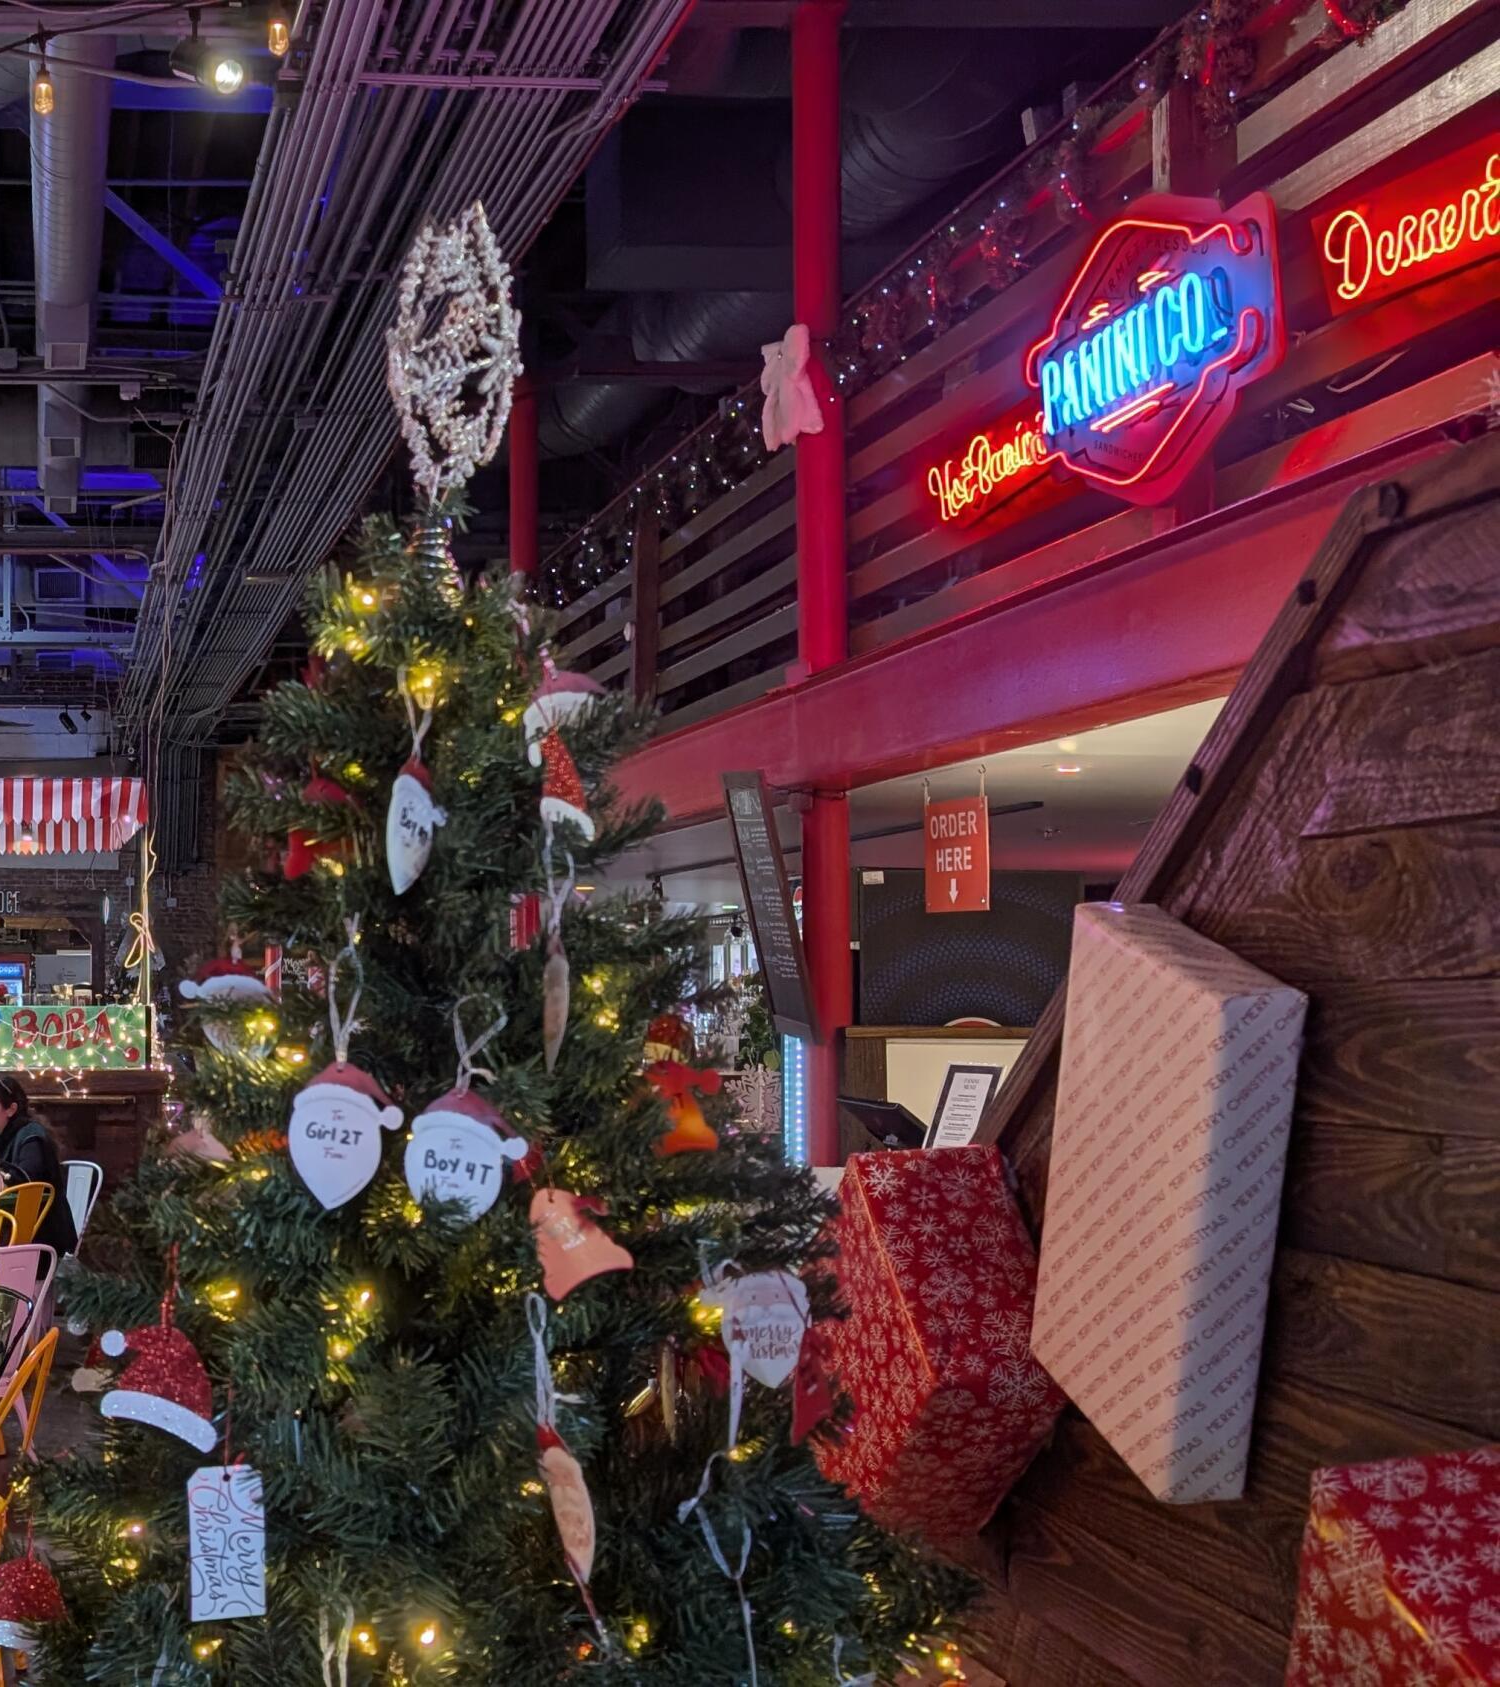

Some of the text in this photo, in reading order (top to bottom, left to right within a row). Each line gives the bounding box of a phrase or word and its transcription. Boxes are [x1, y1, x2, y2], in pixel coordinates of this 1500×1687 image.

[1041, 302, 1152, 437] PANINI
[928, 457, 978, 521] Hot
[930, 810, 978, 841] ORDER
[935, 846, 972, 873] HERE
[11, 1007, 115, 1051] BOBA
[1239, 1030, 1273, 1066] MERRY
[1226, 1055, 1284, 1111] CHRISTMAS
[305, 1121, 363, 1147] Girl 2T
[1222, 1094, 1281, 1149] CHRISTMAS
[424, 1149, 460, 1175] Boy
[1177, 1177, 1232, 1219] CHRISTMAS
[1237, 1138, 1270, 1172] MERRY
[1173, 1214, 1229, 1256] CHRISTMAS
[1232, 1178, 1265, 1212] MERRY
[1180, 1256, 1218, 1286] MERRY
[1218, 1227, 1251, 1260] MERRY
[1214, 1263, 1248, 1296] MERRY
[1202, 1286, 1259, 1340] CHRISTMAS
[1198, 1324, 1256, 1377] CHRISTMAS
[1153, 1400, 1207, 1440] CHRISTMAS
[1211, 1364, 1245, 1398] MERRY
[1206, 1402, 1241, 1434] MERRY
[1192, 1447, 1226, 1480] MERRY
[188, 1485, 232, 1606] Christmas
